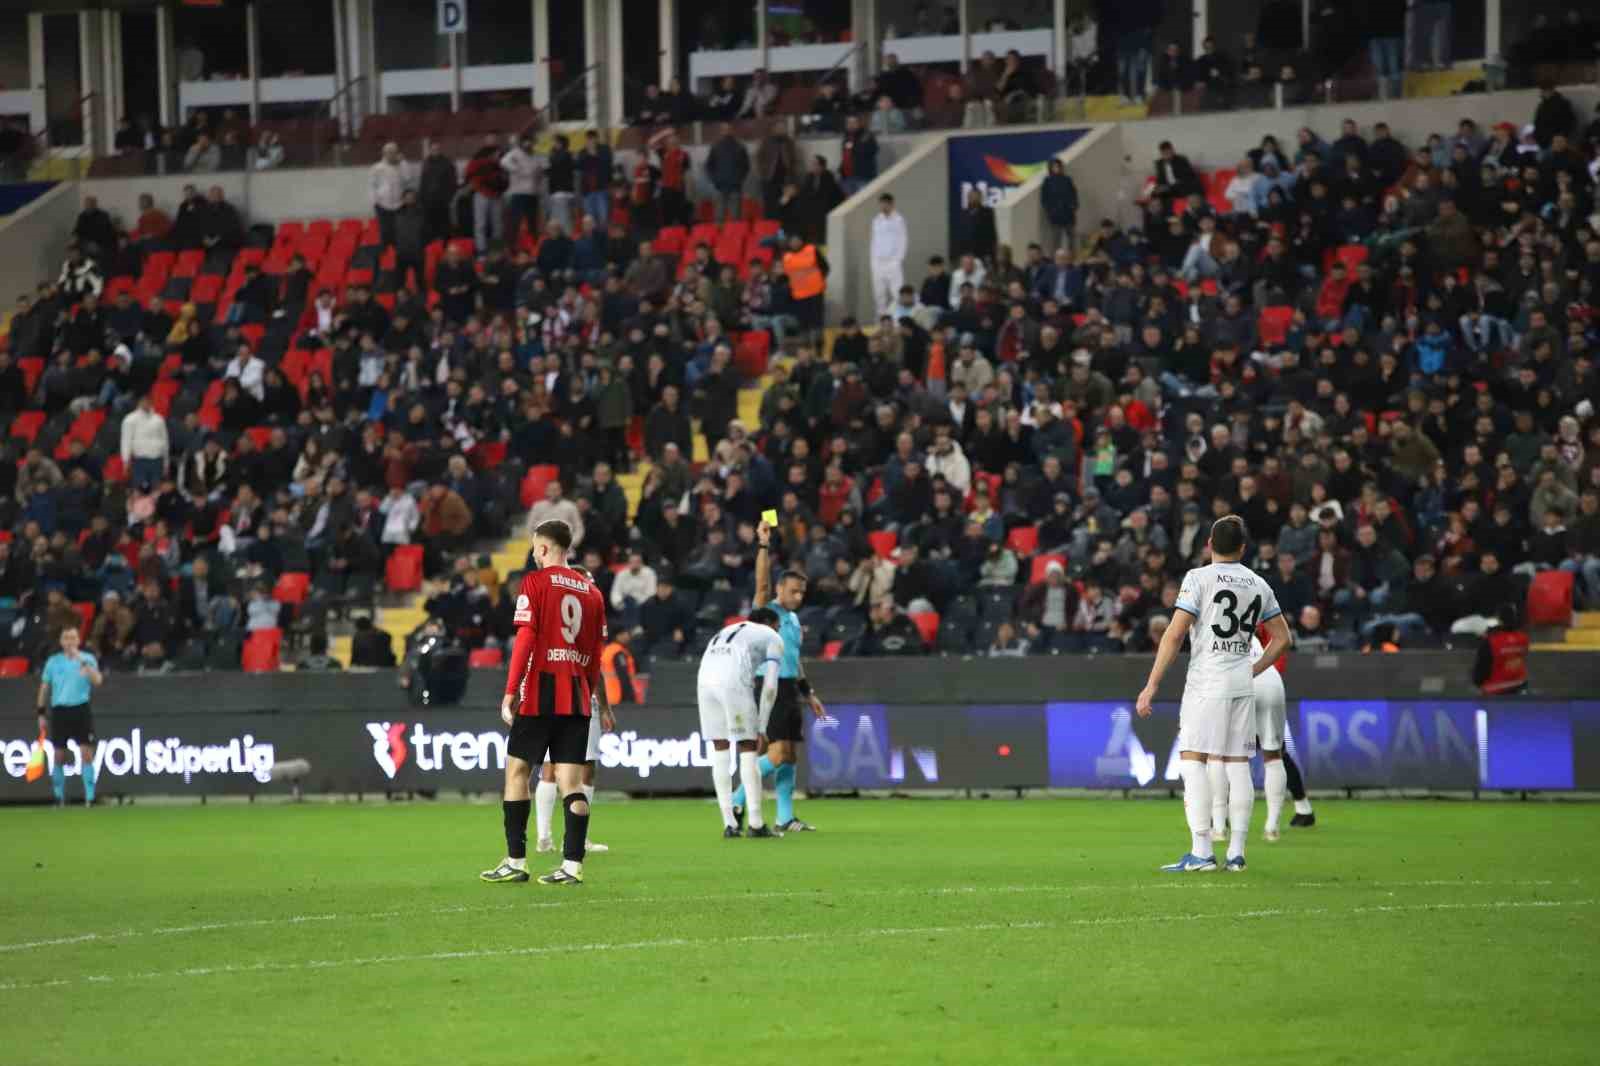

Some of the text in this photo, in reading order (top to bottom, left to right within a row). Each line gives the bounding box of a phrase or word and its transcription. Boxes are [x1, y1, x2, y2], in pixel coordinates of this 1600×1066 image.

[443, 2, 461, 28] D
[560, 594, 582, 644] 9
[1211, 589, 1262, 644] 34
